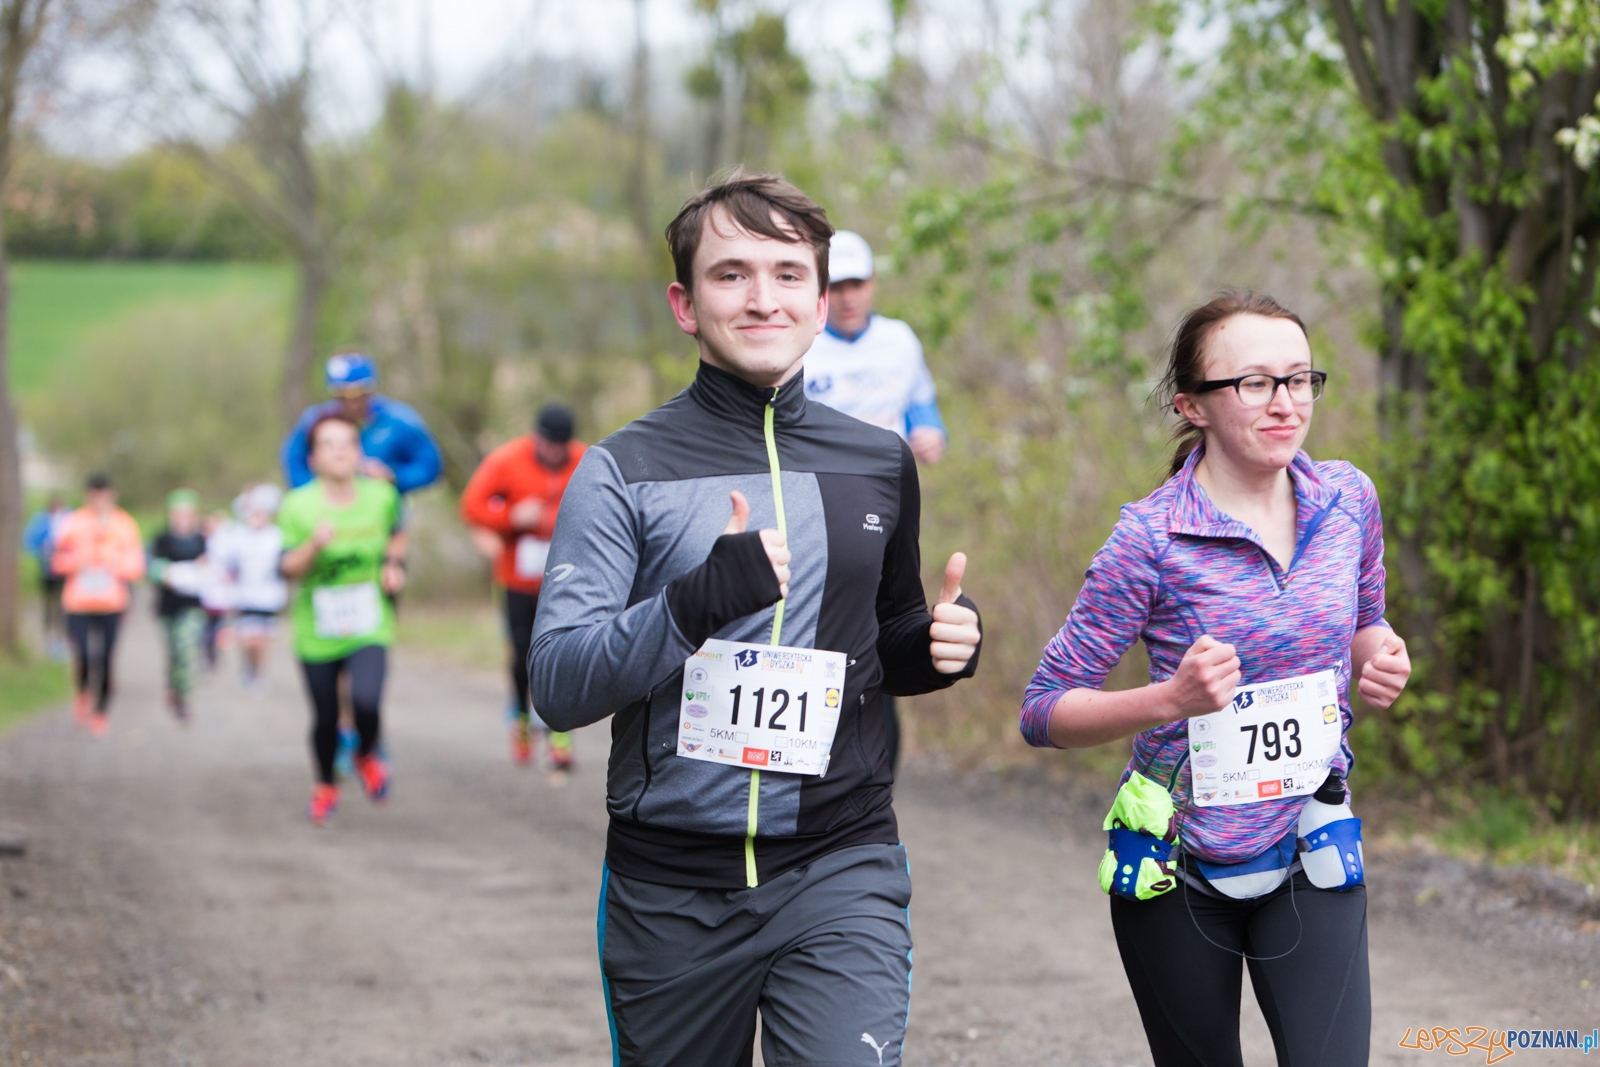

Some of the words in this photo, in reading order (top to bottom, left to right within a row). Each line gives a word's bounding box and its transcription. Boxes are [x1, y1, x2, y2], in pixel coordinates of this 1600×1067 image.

[762, 650, 812, 662] UNIWERSYTECKA
[761, 658, 795, 669] ZADYSZKA
[796, 662, 805, 674] IV
[1256, 681, 1304, 696] UNIWERSYTECKA
[1258, 692, 1290, 704] ZADYSZKA
[1290, 691, 1299, 703] IV
[729, 685, 808, 732] 1121
[710, 728, 735, 741] 5KM
[1240, 718, 1302, 764] 793
[789, 738, 817, 750] 10KM
[1297, 760, 1324, 773] 10KM
[1222, 771, 1247, 783] 5KM
